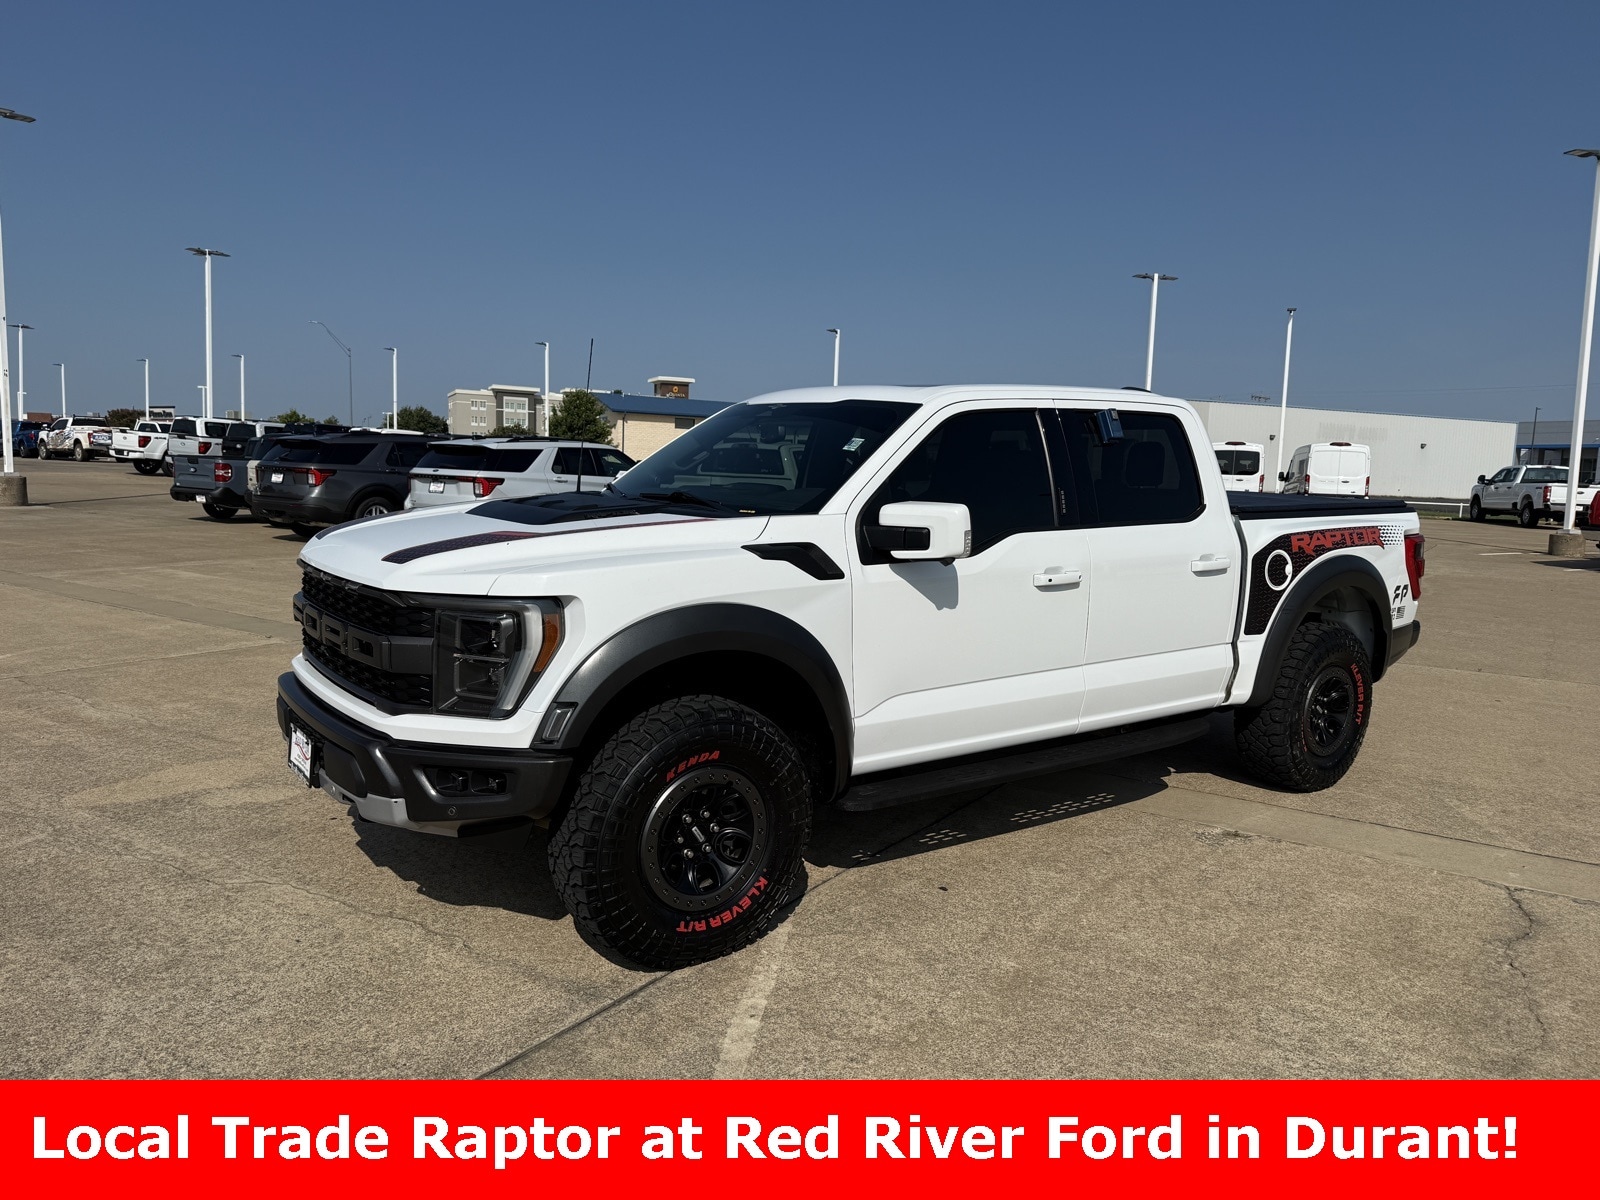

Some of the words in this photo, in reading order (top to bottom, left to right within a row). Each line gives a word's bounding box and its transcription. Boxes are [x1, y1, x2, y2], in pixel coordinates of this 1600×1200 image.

[1290, 528, 1384, 556] RAPTOR
[1351, 663, 1364, 702] KLEVER
[667, 751, 720, 782] KENDA
[709, 876, 768, 928] KLEVER
[676, 920, 706, 932] R/T
